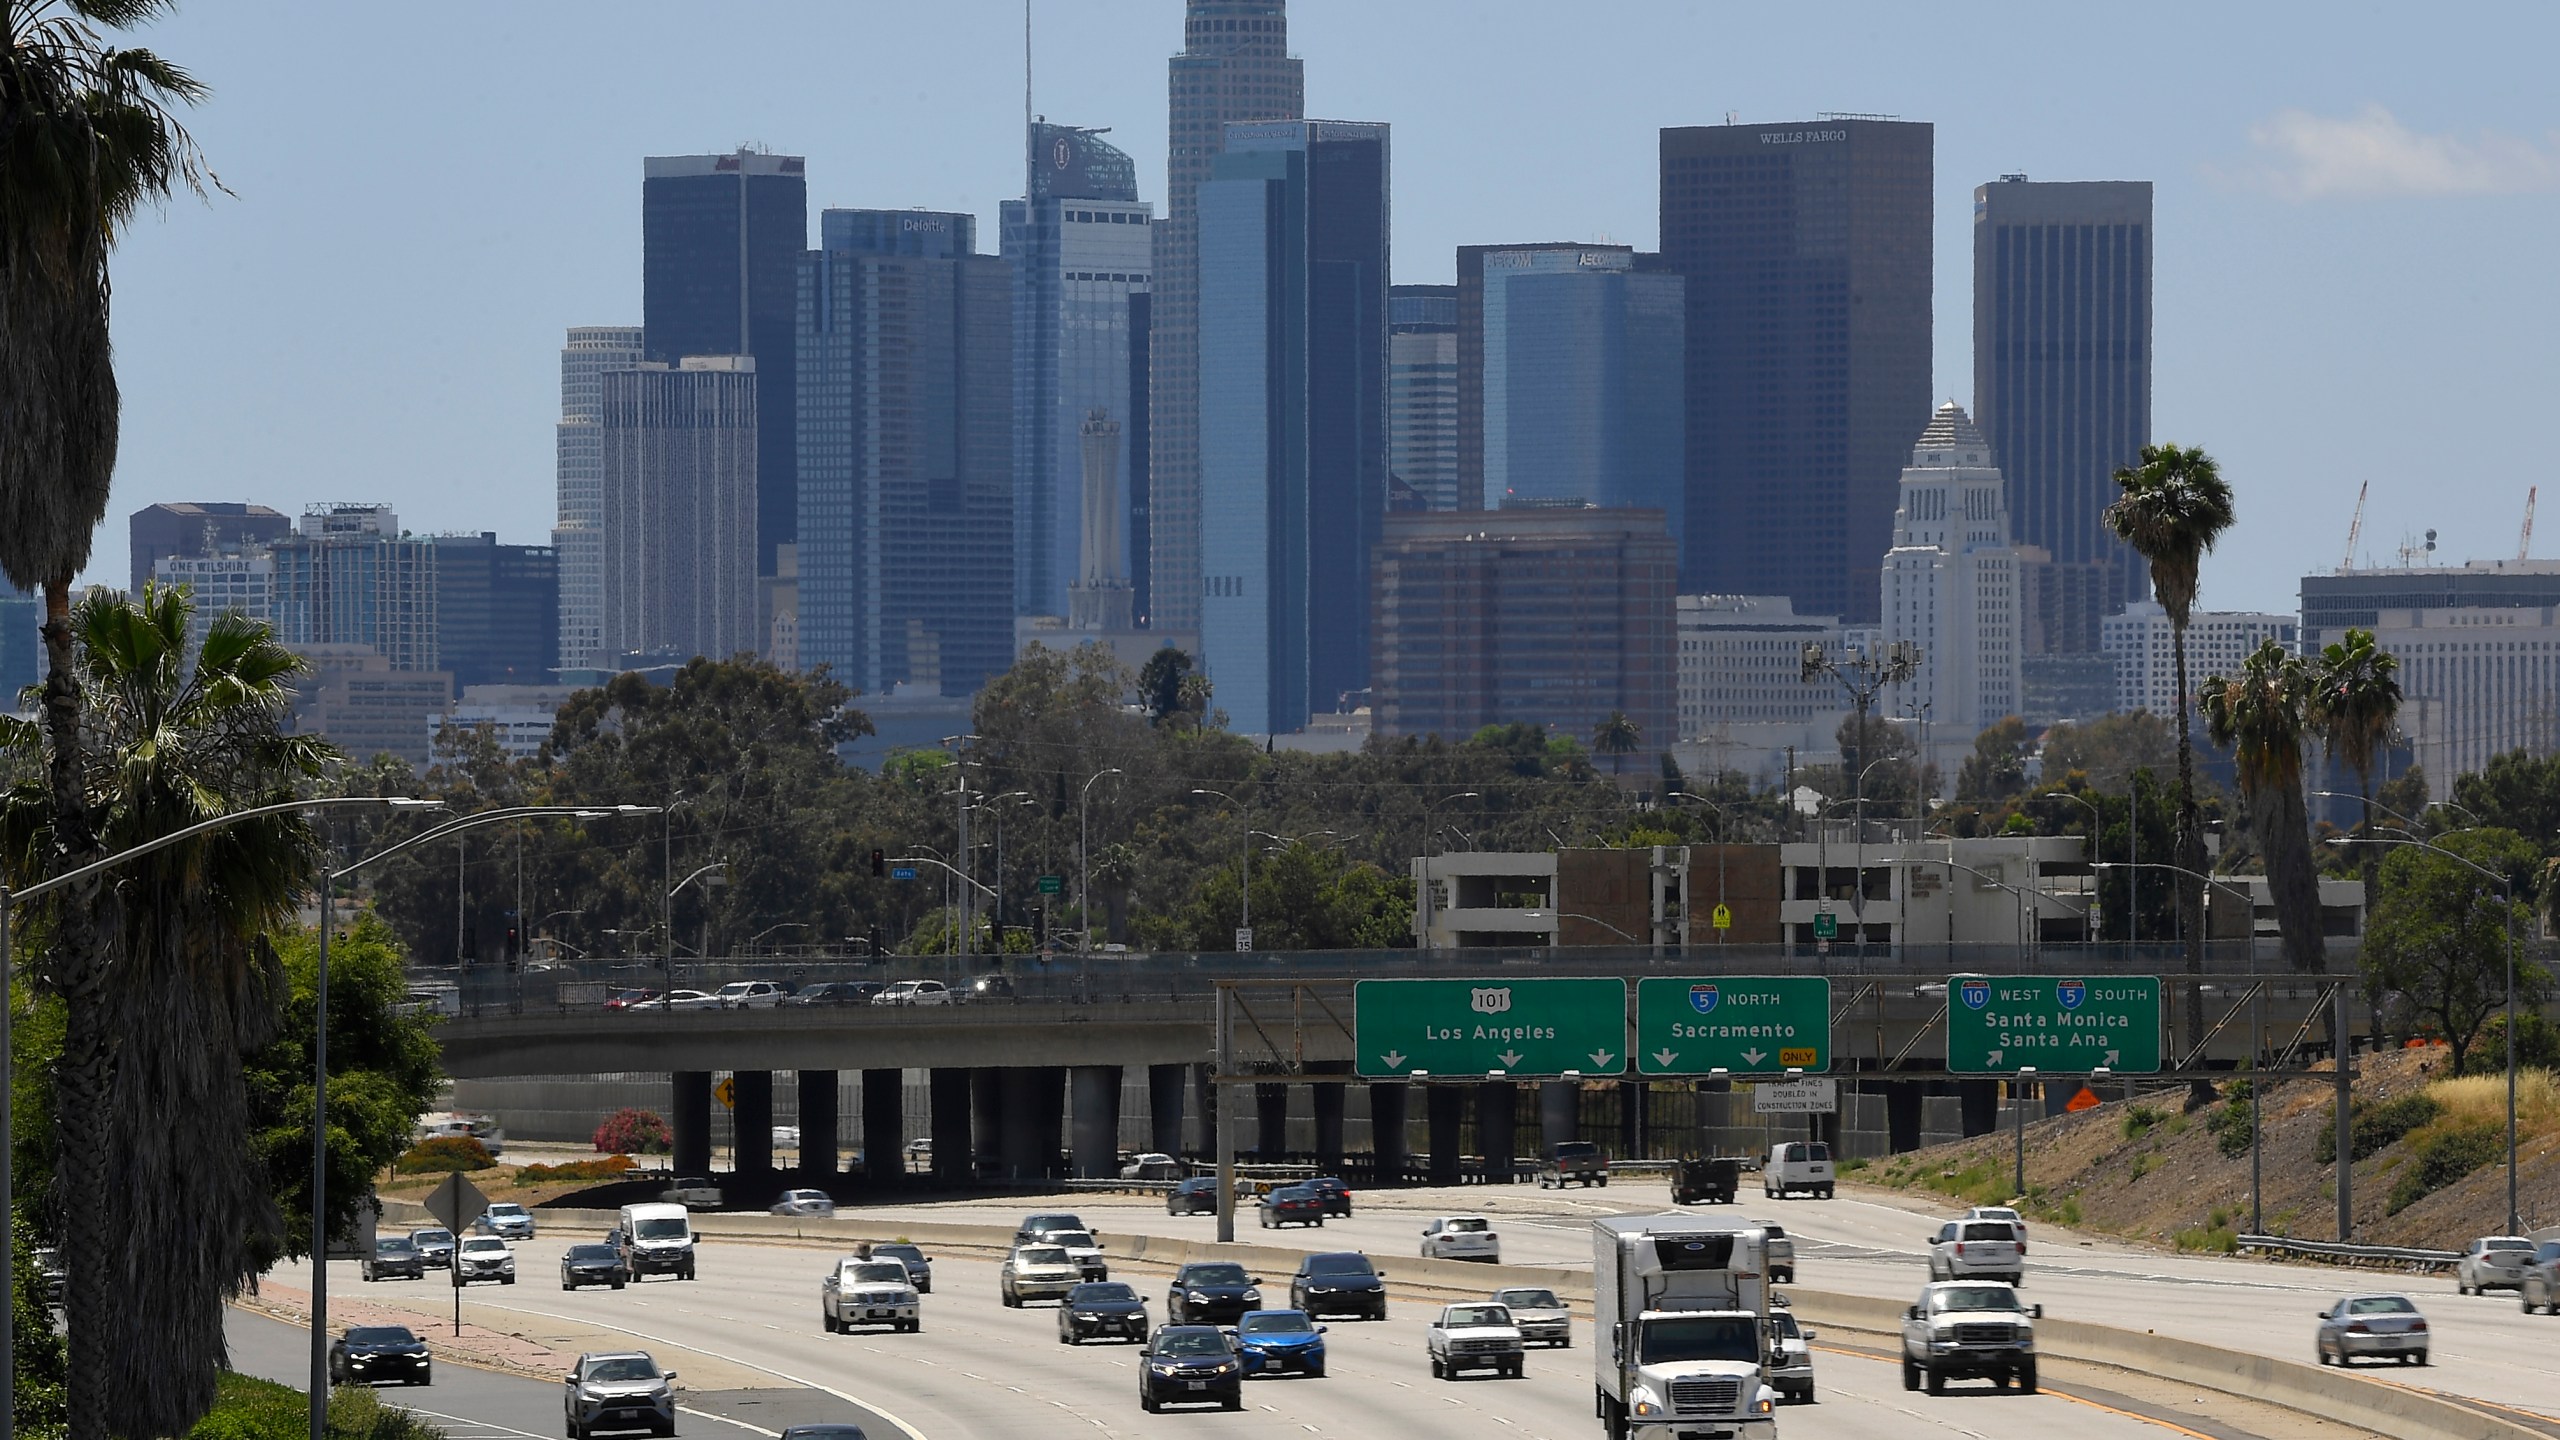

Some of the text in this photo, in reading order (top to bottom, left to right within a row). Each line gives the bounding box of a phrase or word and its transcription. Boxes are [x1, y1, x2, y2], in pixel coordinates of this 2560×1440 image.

[1760, 130, 1846, 144] WELLS FARGO
[903, 218, 946, 233] Deloitte
[1578, 252, 1613, 267] AECOM
[169, 561, 252, 573] ONE WILSHIRE
[1237, 941, 1251, 951] 35
[1478, 994, 1505, 1008] 101
[1699, 994, 1780, 1008] 5 NORTH
[1968, 989, 2148, 1004] 10 WEST 5 SOUTH
[1985, 1012, 2129, 1027] Santa Monica
[1426, 1025, 1555, 1044] Los Angeles
[1672, 1023, 1795, 1038] Sacramento
[1999, 1032, 2108, 1047] Santa Ana
[1782, 1052, 1813, 1062] ONLY
[1773, 1090, 1806, 1098] DOUBLED
[1757, 1101, 1833, 1110] CONSTRUCTION ZONES
